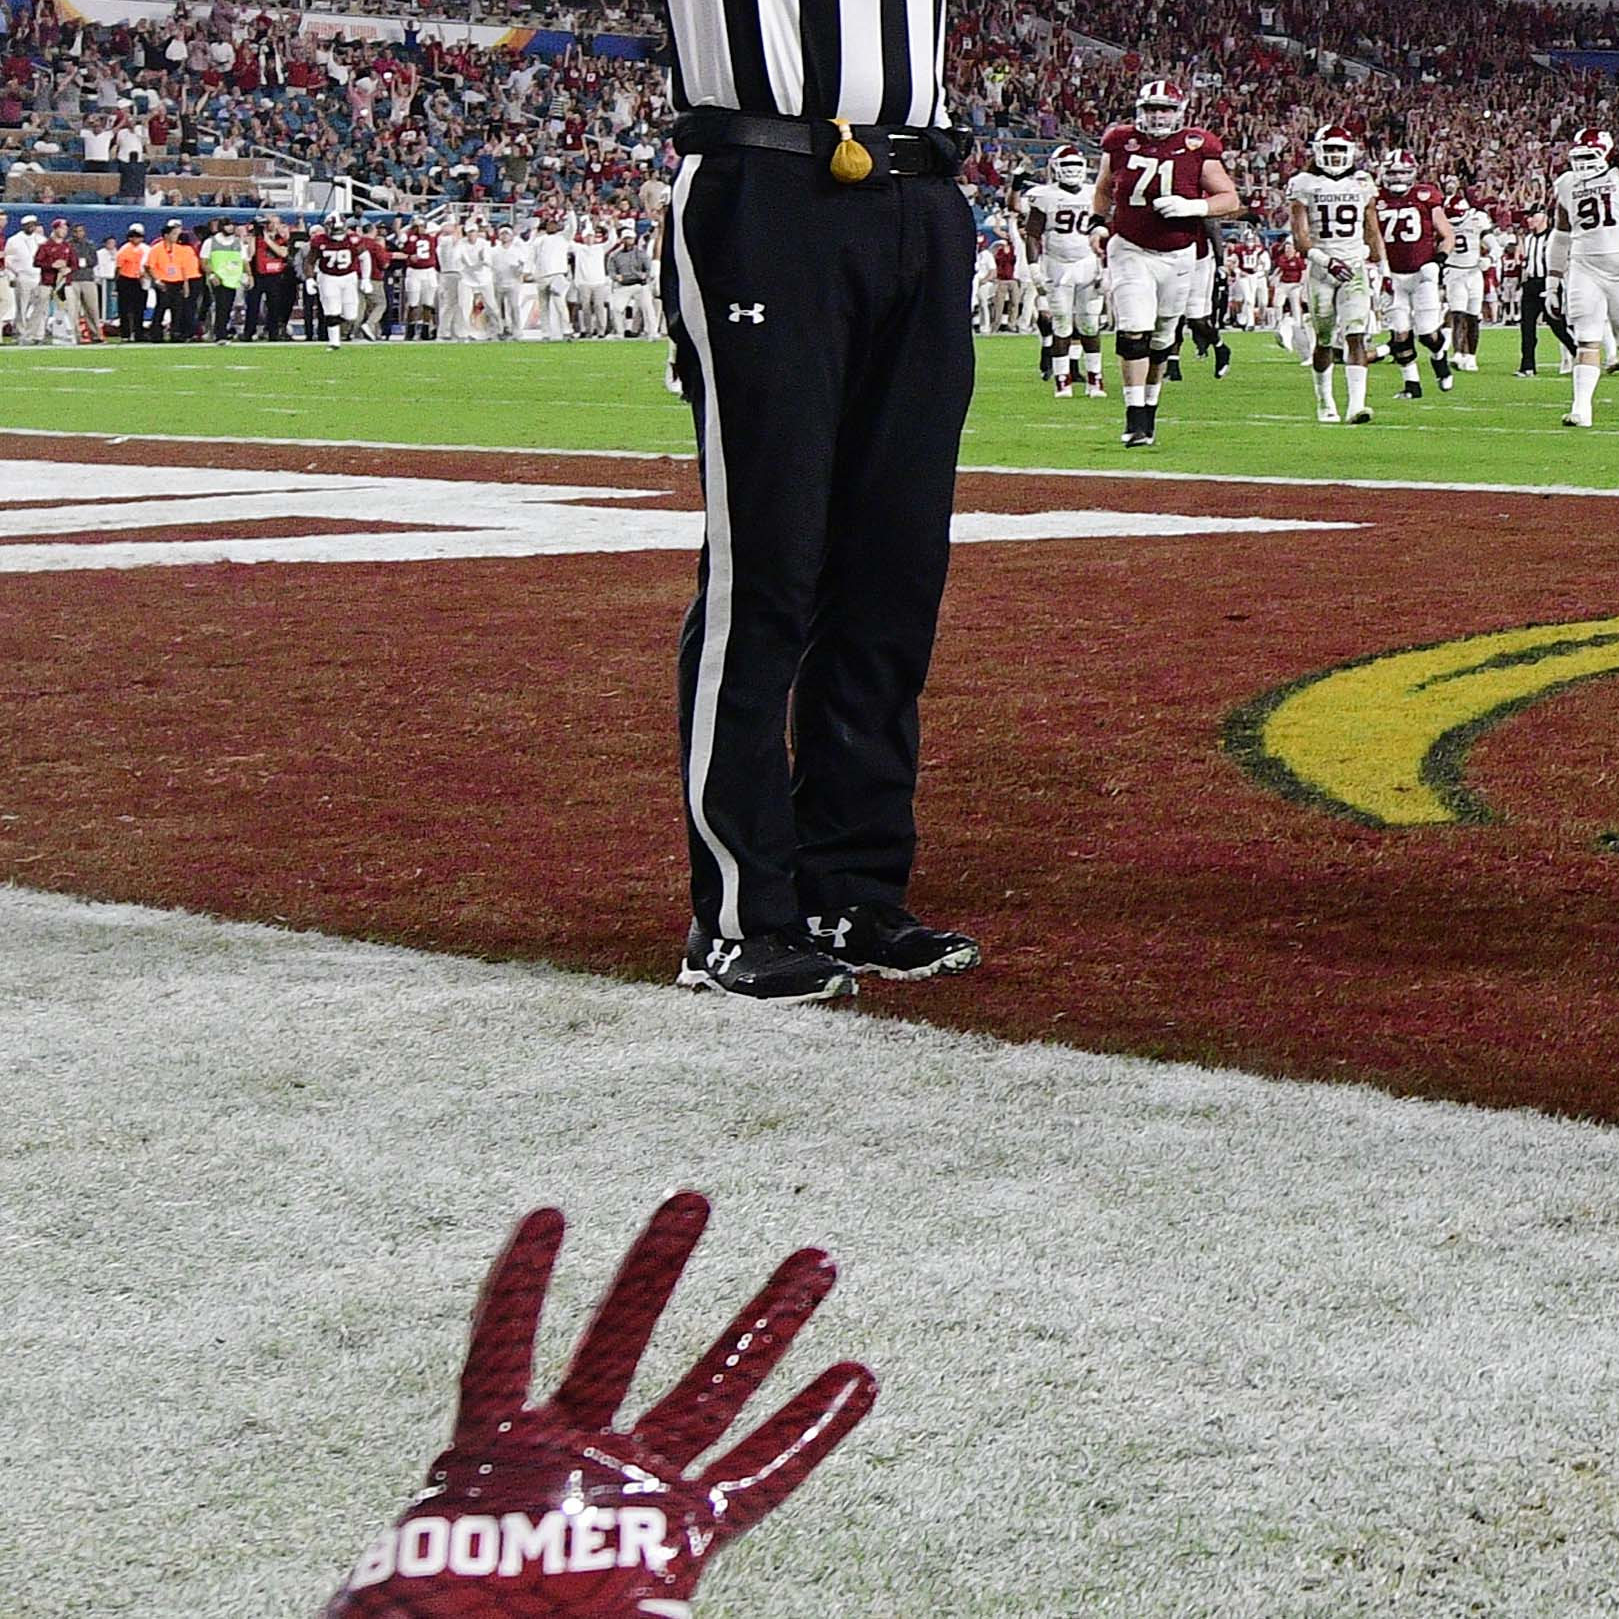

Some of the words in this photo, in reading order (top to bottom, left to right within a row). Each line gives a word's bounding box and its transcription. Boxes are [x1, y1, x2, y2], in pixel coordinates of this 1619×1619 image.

[1126, 153, 1175, 208] 71
[1317, 204, 1358, 239] 19
[1377, 206, 1422, 243] 73
[1577, 193, 1617, 230] 91
[322, 248, 352, 270] 79
